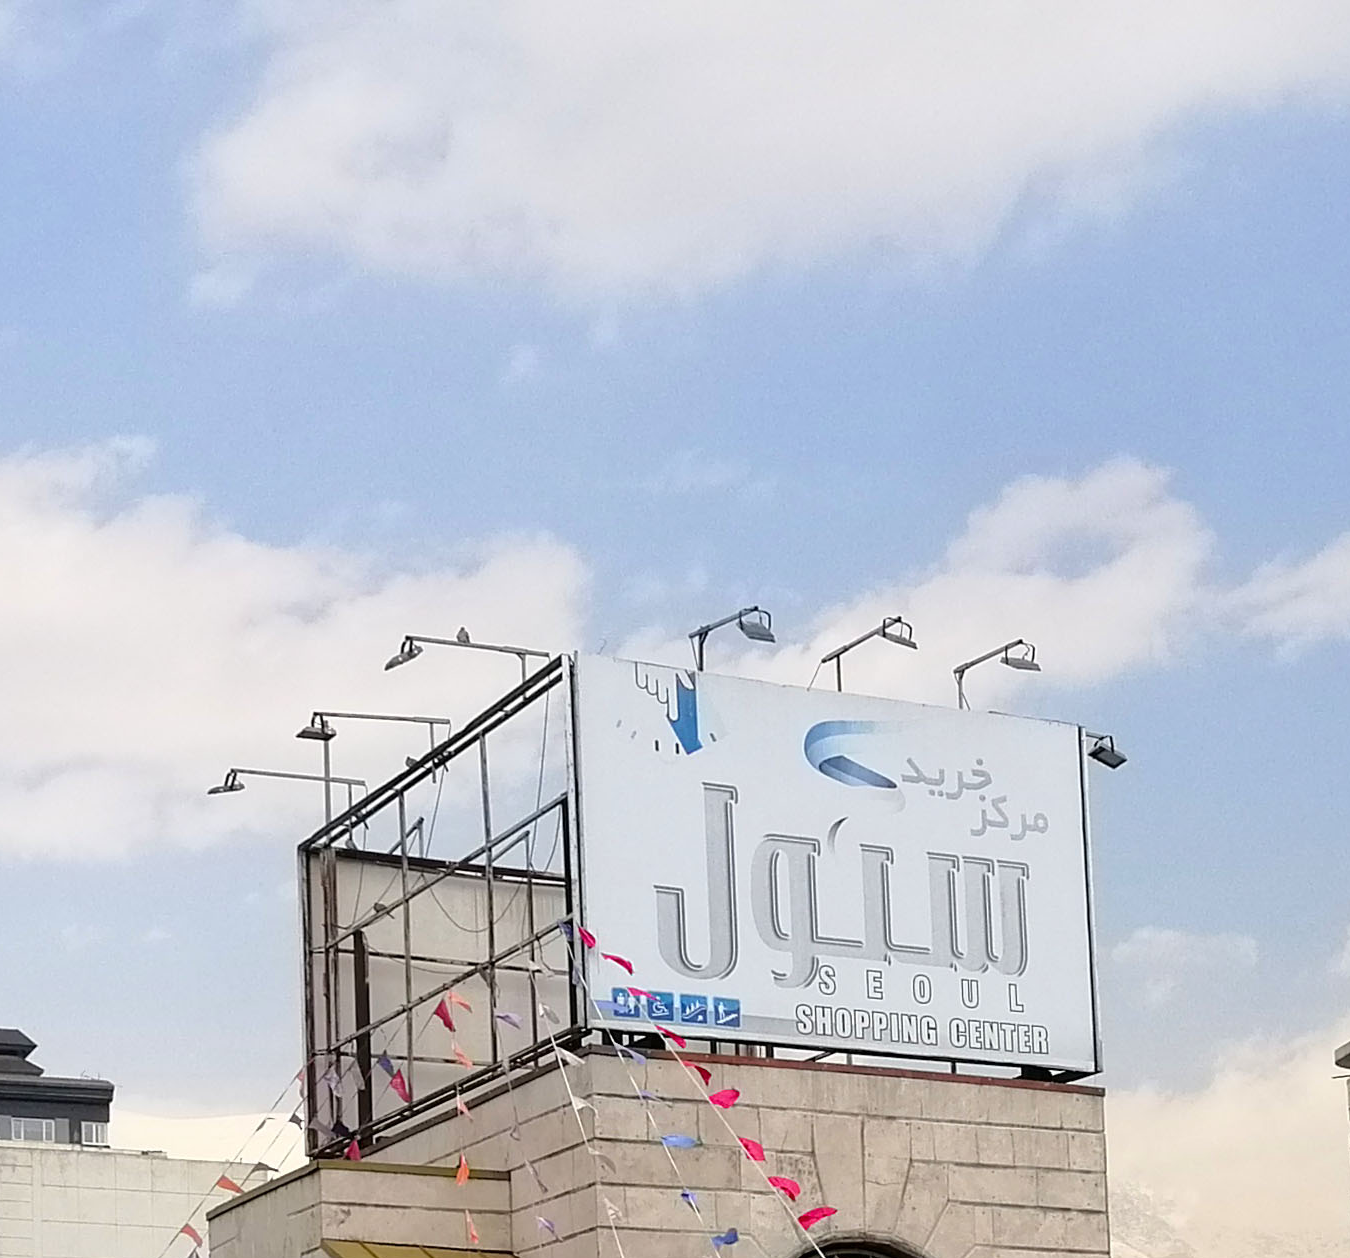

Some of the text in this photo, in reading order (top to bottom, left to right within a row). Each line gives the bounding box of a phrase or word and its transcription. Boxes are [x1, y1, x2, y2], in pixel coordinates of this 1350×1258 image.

[901, 758, 993, 800] خرید
[970, 794, 1049, 841] مرکز
[818, 965, 1025, 1013] SEOUL
[795, 1003, 1049, 1055] SHOPPING CENTER
